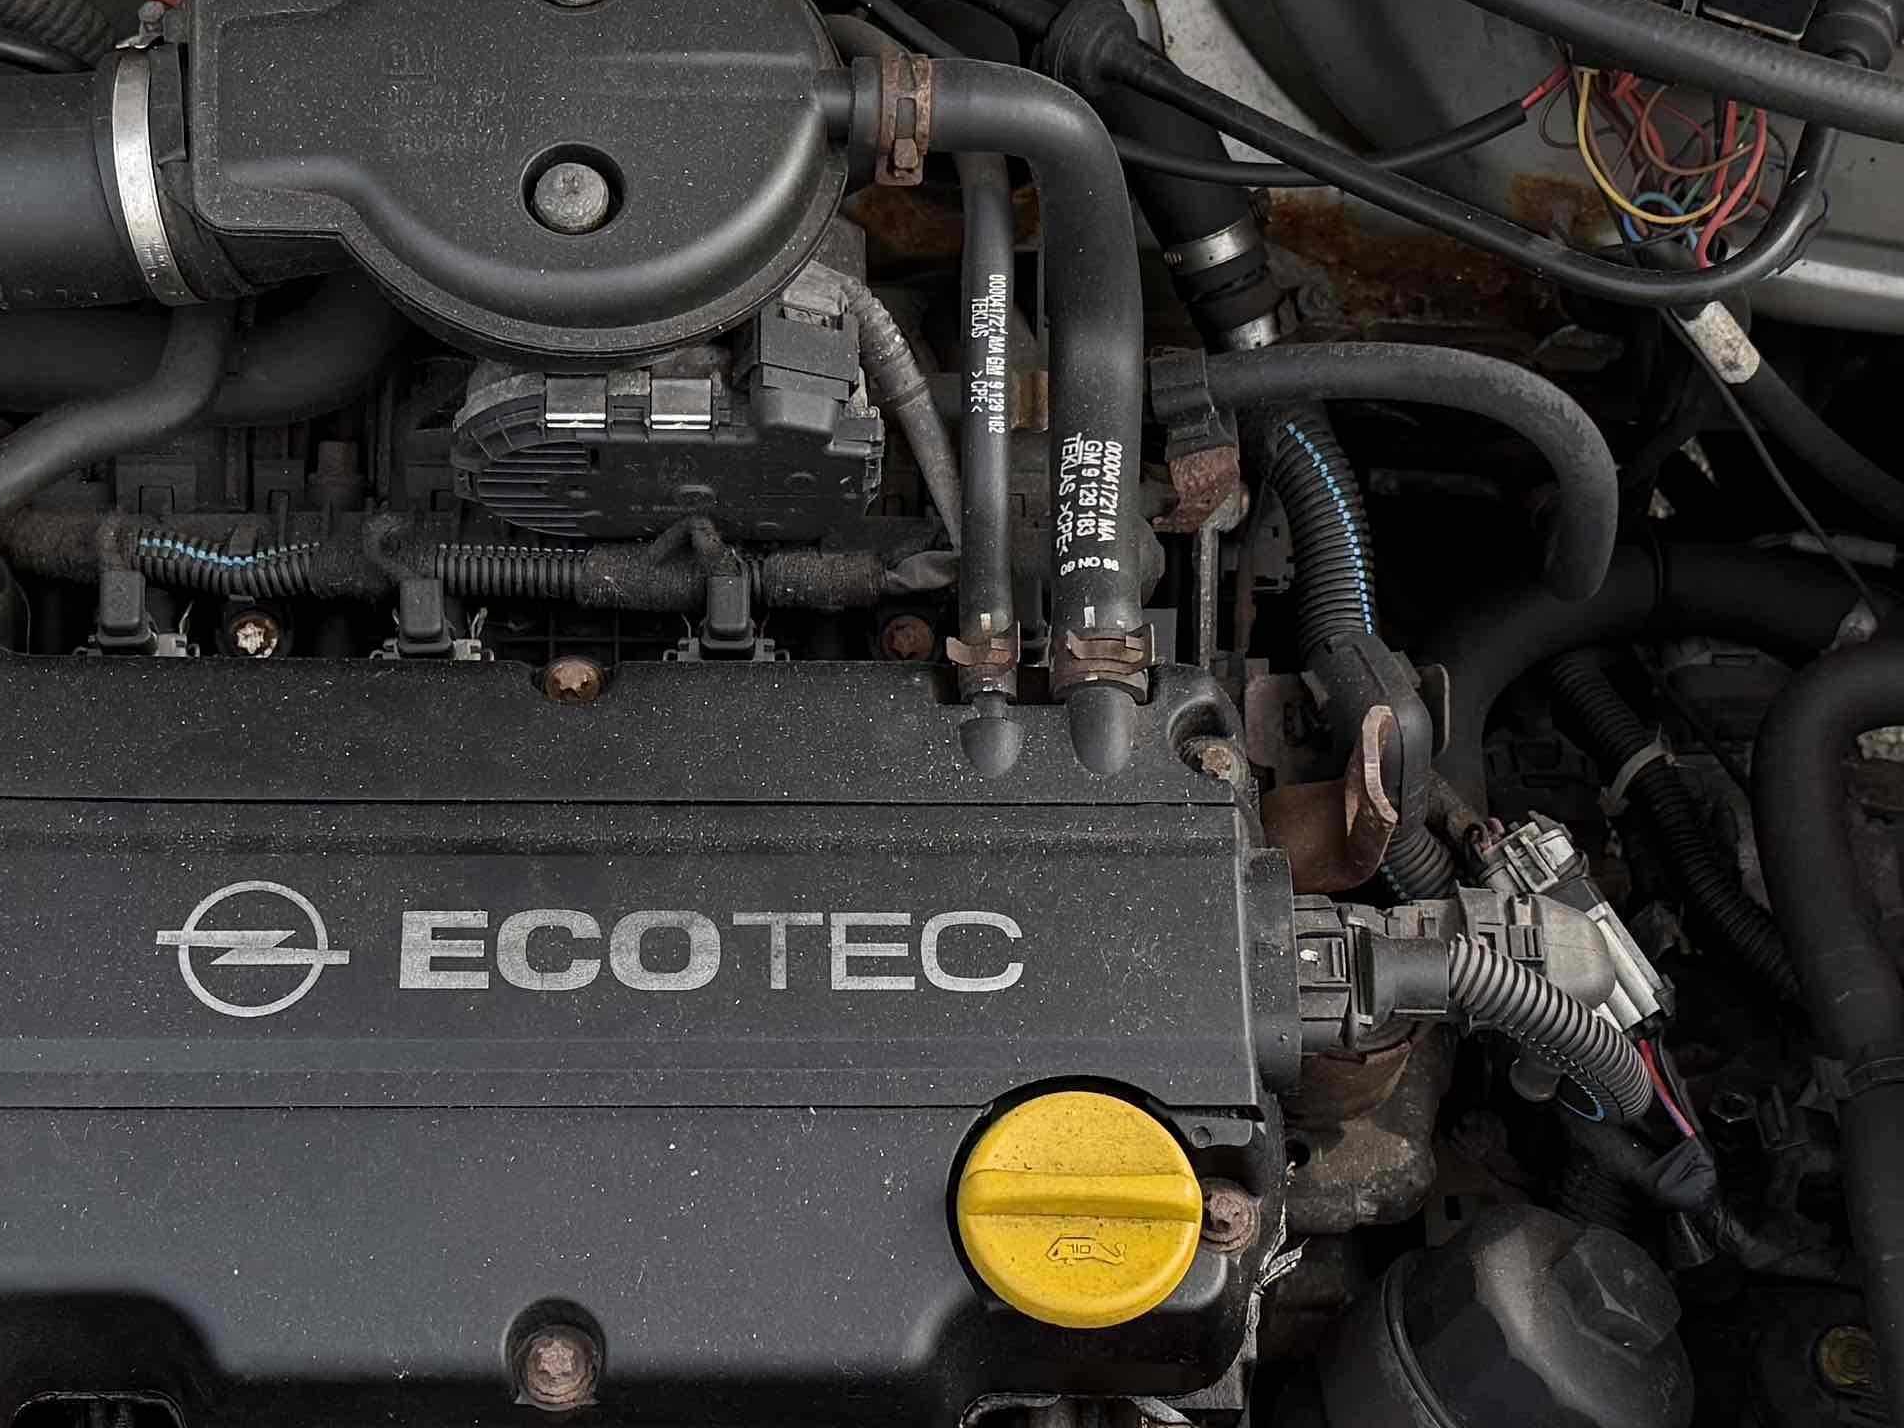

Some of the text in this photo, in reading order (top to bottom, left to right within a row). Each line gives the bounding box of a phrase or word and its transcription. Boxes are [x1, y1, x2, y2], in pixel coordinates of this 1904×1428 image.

[970, 297, 988, 339] TEKLAS
[987, 380, 1005, 390] 9
[987, 391, 1005, 412] 129
[1057, 431, 1083, 497] TEKLAS
[1081, 439, 1103, 466] GM
[1080, 467, 1100, 479] 9
[1077, 481, 1100, 507] 129
[398, 908, 1026, 993] ECOTEC
[1065, 1243, 1092, 1256] OIL
